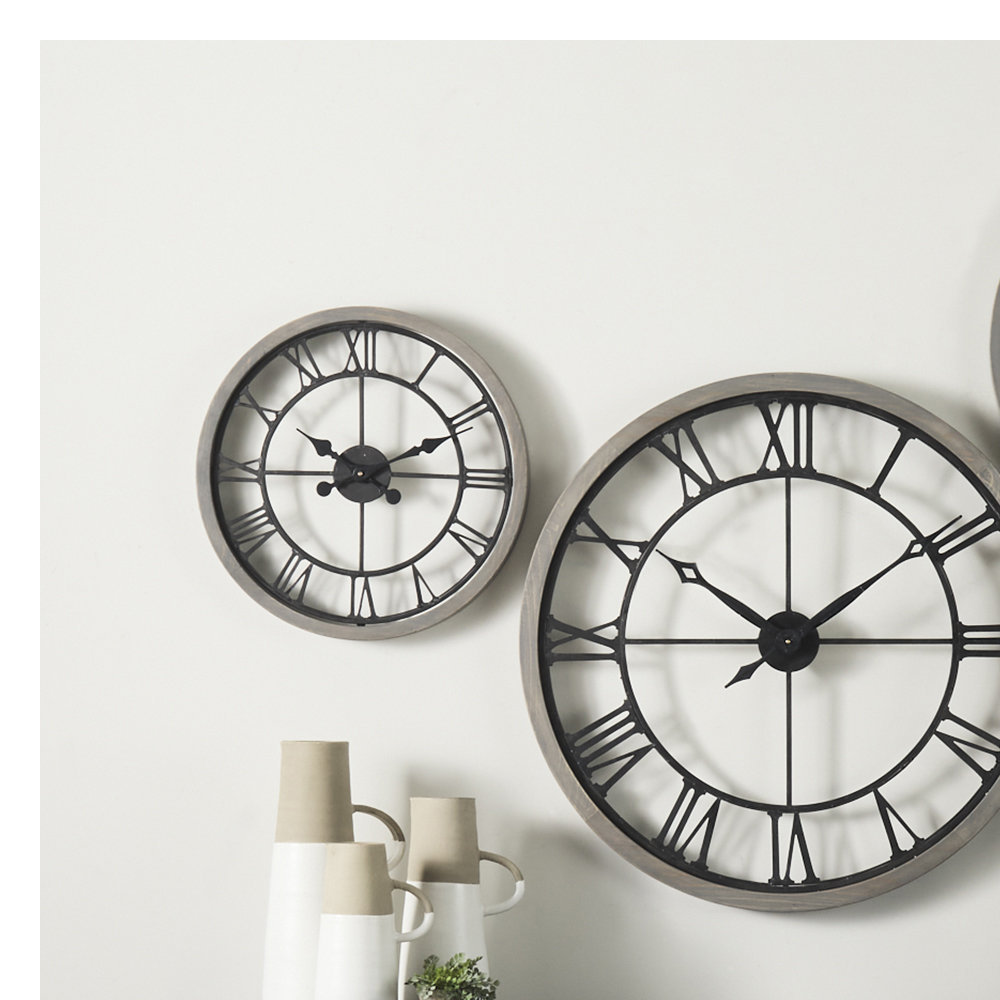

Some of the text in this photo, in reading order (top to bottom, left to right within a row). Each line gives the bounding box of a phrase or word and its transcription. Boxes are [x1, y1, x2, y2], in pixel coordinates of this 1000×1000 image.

[281, 338, 325, 393] XI
[343, 328, 379, 374] XII
[235, 386, 282, 429] X
[649, 420, 725, 504] XI
[755, 400, 818, 476] XII
[462, 467, 511, 492] III
[448, 517, 494, 563] IV
[569, 507, 649, 574] X
[273, 548, 314, 602] VII
[350, 576, 379, 619] VI
[653, 776, 720, 870] VII
[767, 811, 819, 884] VI
